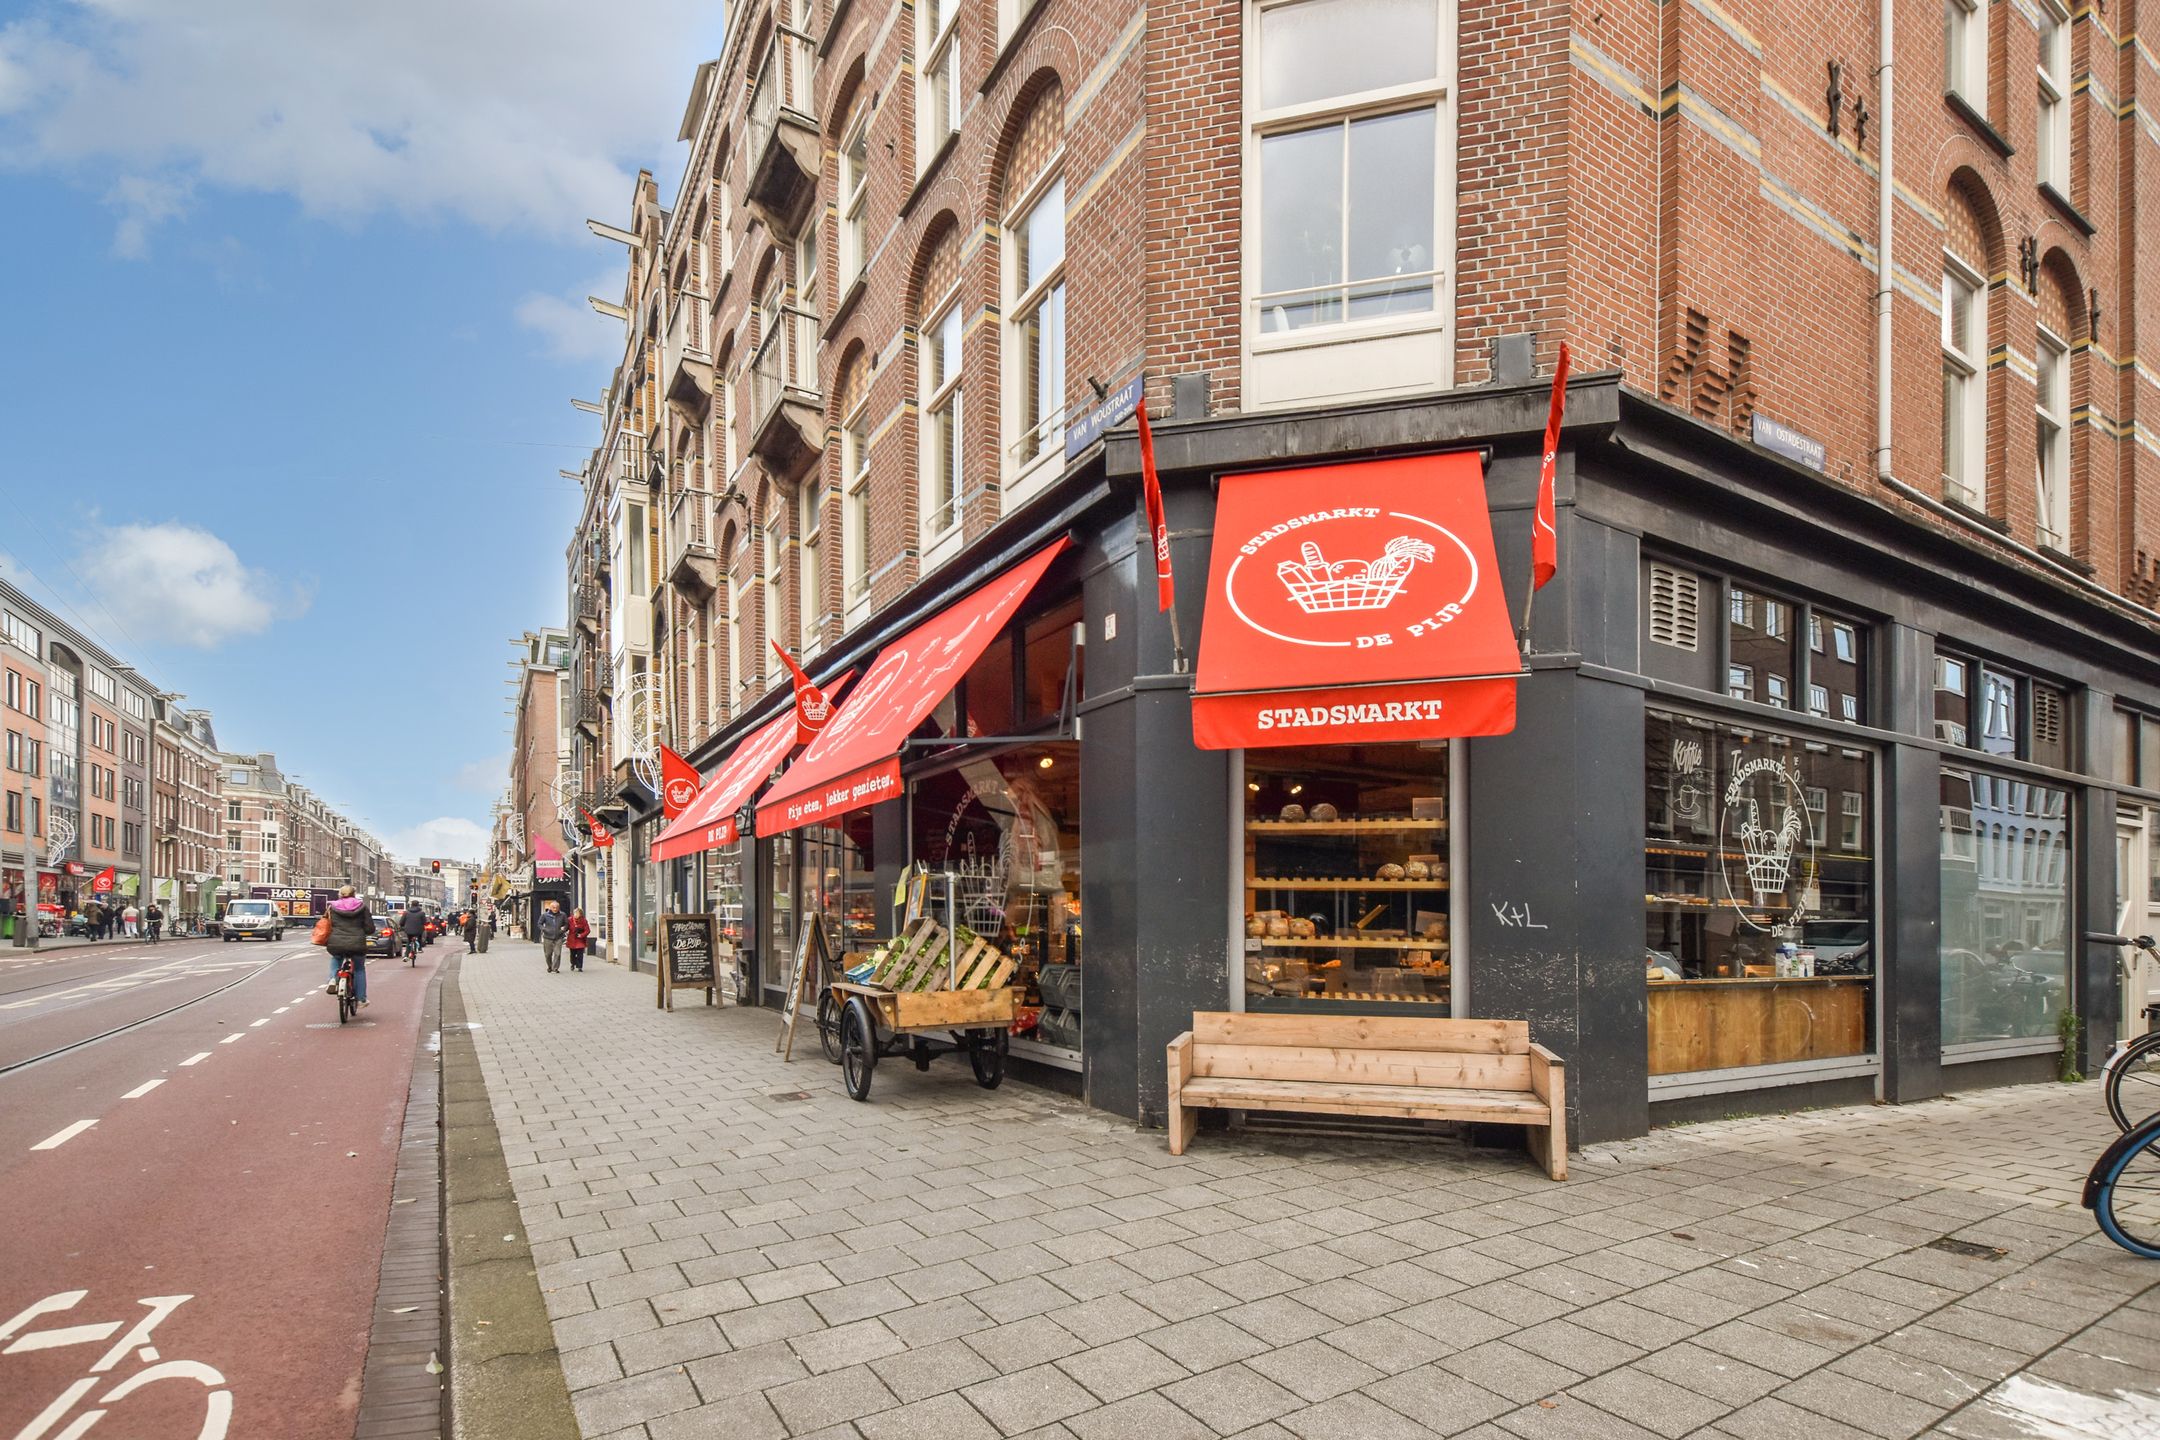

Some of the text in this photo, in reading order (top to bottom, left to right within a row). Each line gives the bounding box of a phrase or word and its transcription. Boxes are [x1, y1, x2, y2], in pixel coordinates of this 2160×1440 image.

[1073, 422, 1087, 440] VAN
[1091, 385, 1134, 427] WOUSTRAAT
[1757, 419, 1772, 436] VAN
[1240, 507, 1380, 556] STADSMARKT
[1356, 601, 1464, 649] DE PIJP
[1257, 700, 1442, 730] STADSMARKT
[826, 788, 849, 808] lekker
[852, 774, 895, 802] genieten.
[1724, 757, 1783, 807] STADSMARKT
[1772, 925, 1784, 938] DE
